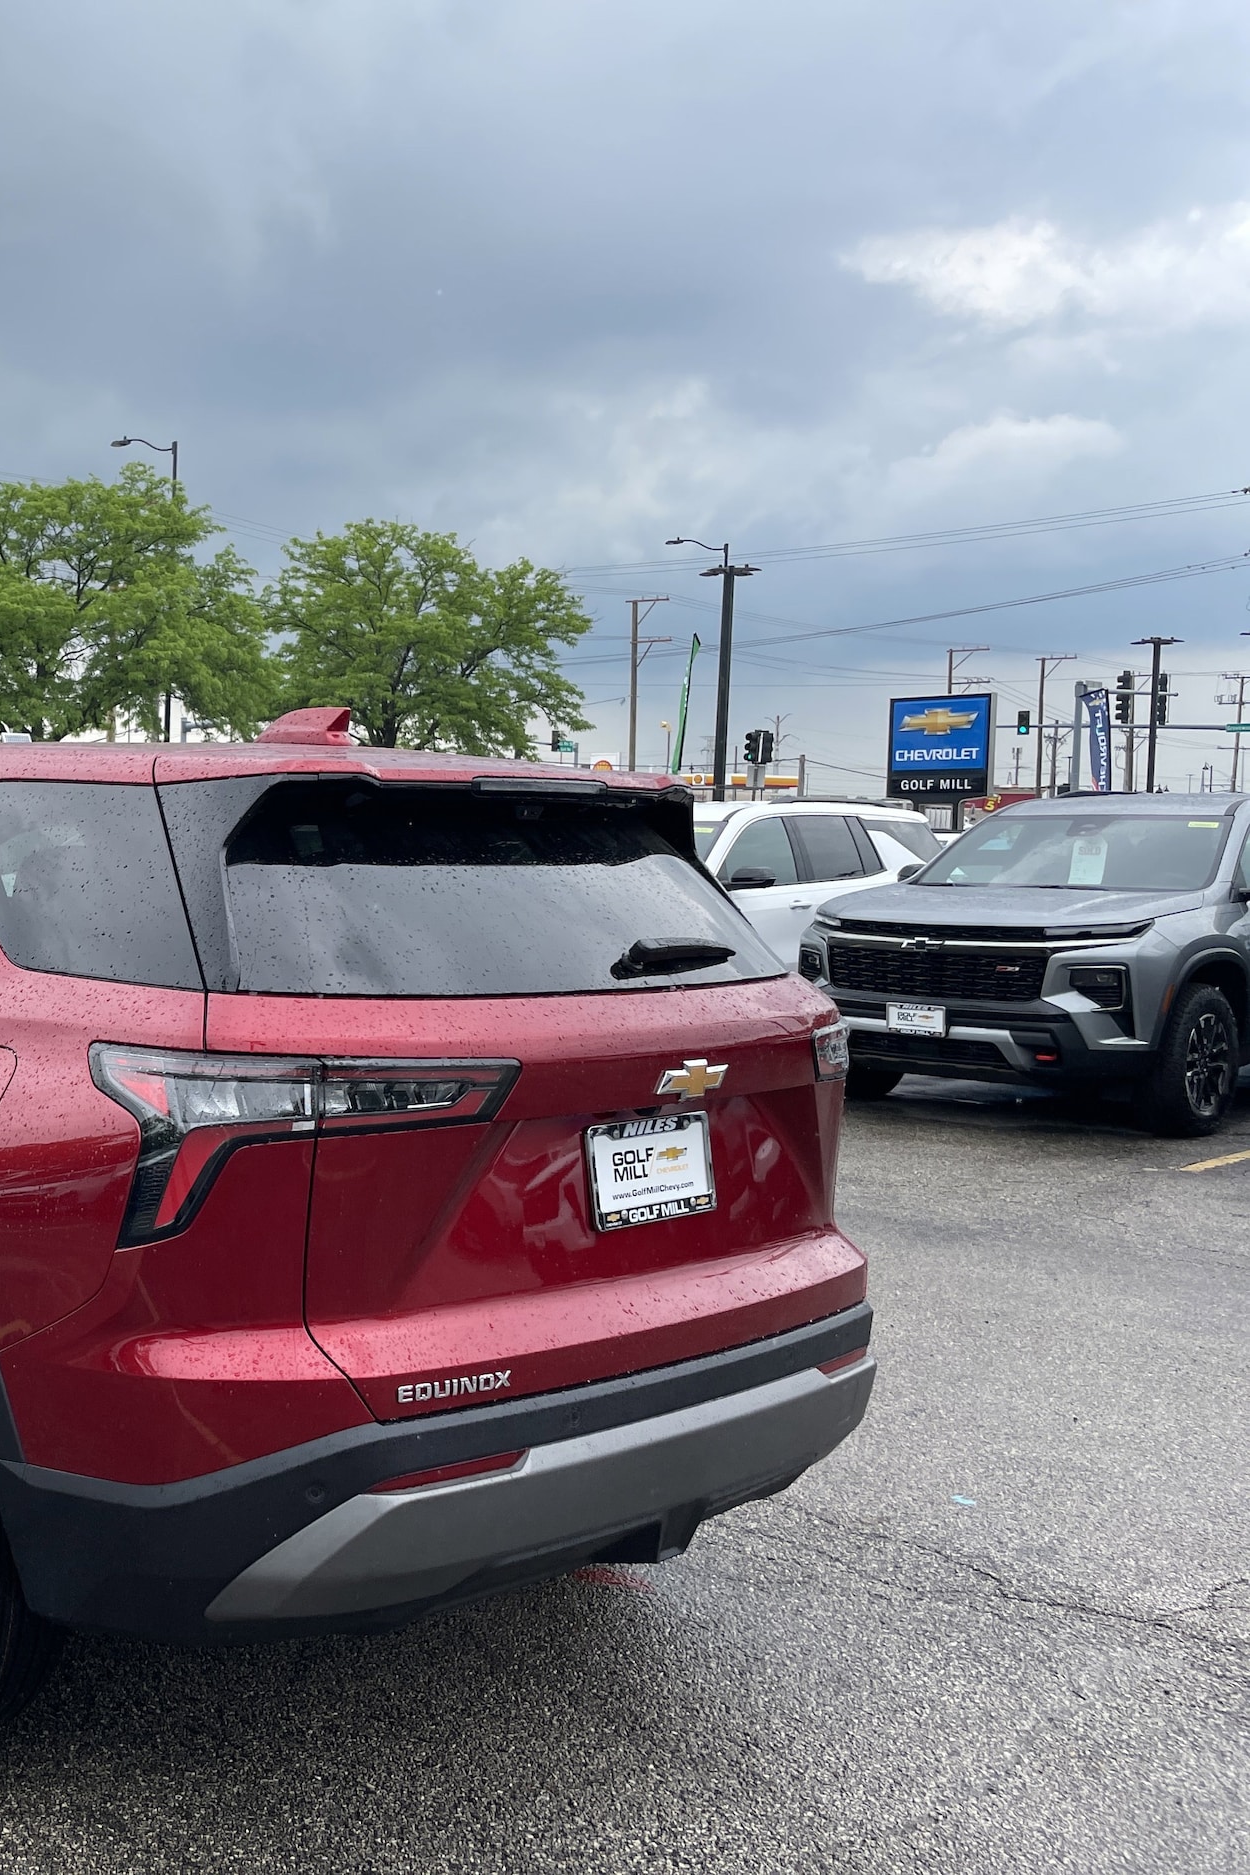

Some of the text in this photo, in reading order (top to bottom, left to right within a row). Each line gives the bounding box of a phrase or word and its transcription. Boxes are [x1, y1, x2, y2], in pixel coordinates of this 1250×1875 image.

[895, 747, 980, 761] CHEVROLET
[900, 779, 972, 791] GOLF MILL
[623, 1117, 678, 1137] NILES
[612, 1147, 654, 1167] GOLF
[614, 1164, 649, 1182] MILL
[656, 1163, 689, 1174] CHEVROLET
[612, 1181, 695, 1200] www.GolfMillChevy.com
[628, 1204, 660, 1223] GOLF
[661, 1200, 690, 1217] MILL
[397, 1369, 512, 1403] EQUINOX
